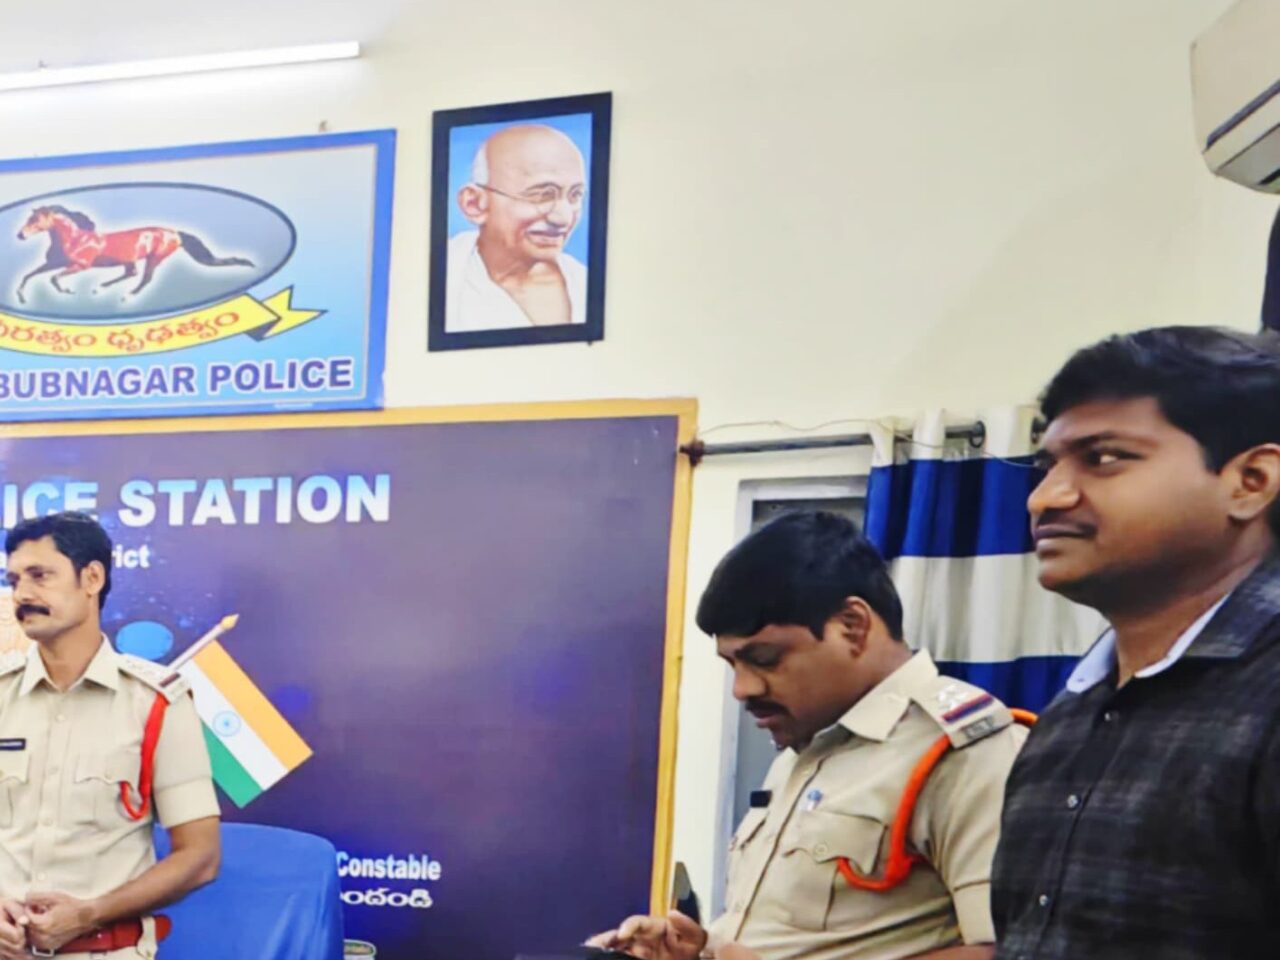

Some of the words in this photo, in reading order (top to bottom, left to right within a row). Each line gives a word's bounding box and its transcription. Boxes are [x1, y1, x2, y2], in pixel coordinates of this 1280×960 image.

[209, 359, 352, 392] POLICE
[118, 474, 391, 527] STATION
[336, 851, 441, 881] Constable
